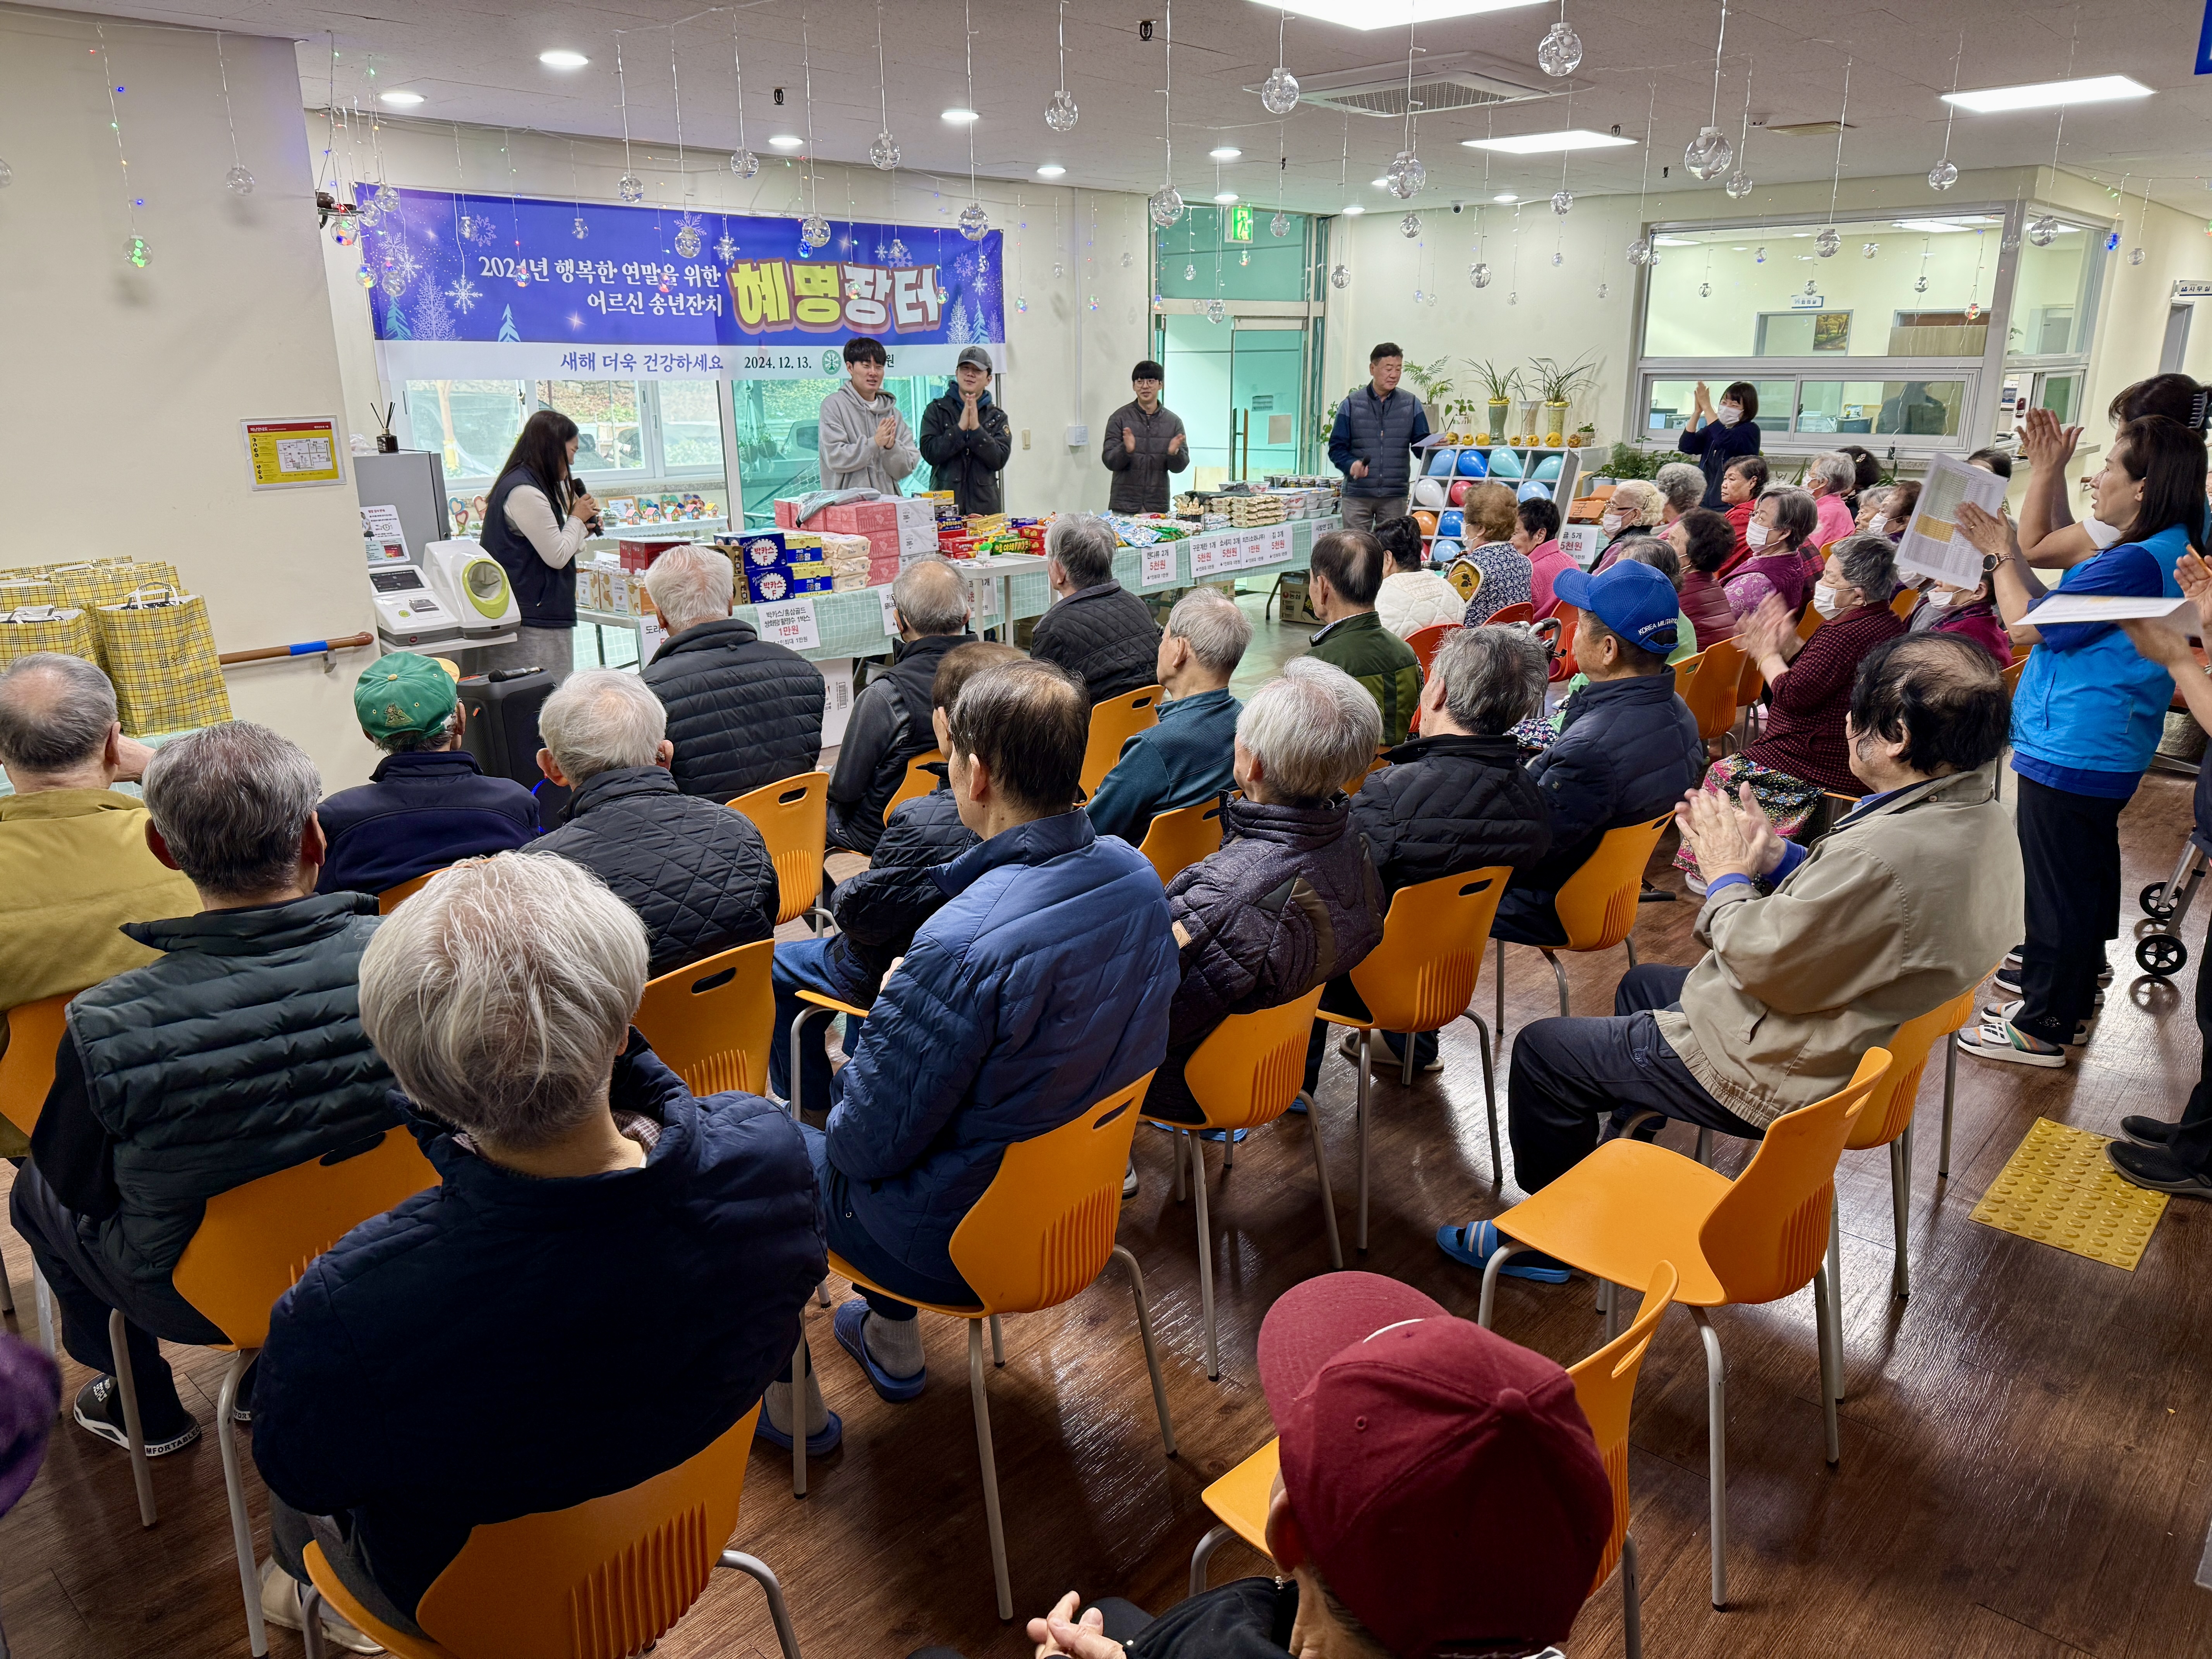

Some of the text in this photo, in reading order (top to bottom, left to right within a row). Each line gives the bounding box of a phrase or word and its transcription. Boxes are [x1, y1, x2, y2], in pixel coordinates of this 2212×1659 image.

[555, 260, 618, 284] 행복한
[622, 263, 678, 286] 연말을
[684, 265, 721, 288] 위한
[730, 259, 941, 328] 혜명장터
[588, 291, 722, 317] 어르신 송년잔치
[560, 352, 724, 373] 새해 더욱 건강하세요
[745, 357, 812, 369] 2024. 12. 13.
[1272, 539, 1285, 550] 5천원
[1560, 541, 1582, 551] 5천원
[754, 546, 774, 555] 박카스
[1223, 547, 1237, 557] 5천원
[1198, 552, 1211, 562] 5천원
[1150, 560, 1166, 570] 5천원
[764, 580, 783, 589] 박카스
[766, 607, 806, 618] 박카스/홍삼골드
[779, 625, 799, 636] 1만원
[1638, 623, 1657, 635] KOREA
